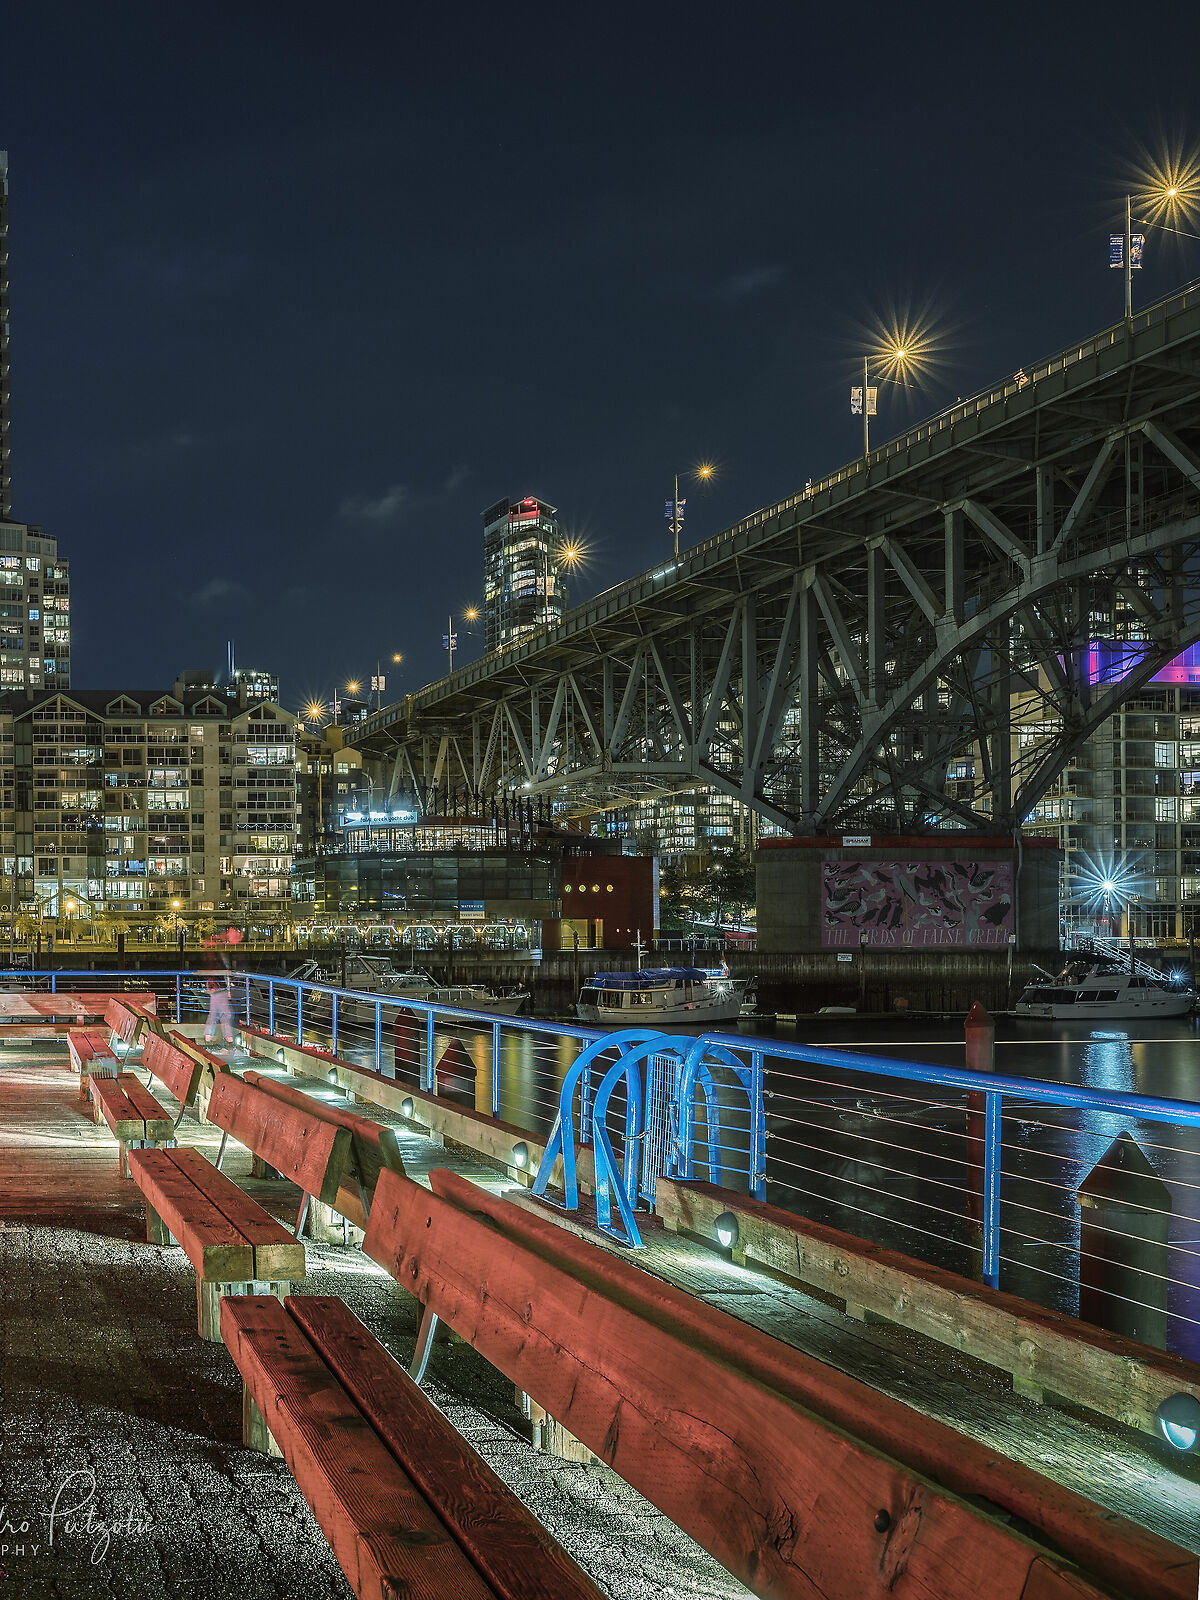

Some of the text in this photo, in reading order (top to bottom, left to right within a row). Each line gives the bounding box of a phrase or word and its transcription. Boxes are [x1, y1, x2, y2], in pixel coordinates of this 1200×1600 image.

[825, 929, 851, 945] THE
[902, 929, 918, 945] OF
[923, 929, 963, 944] FALSE
